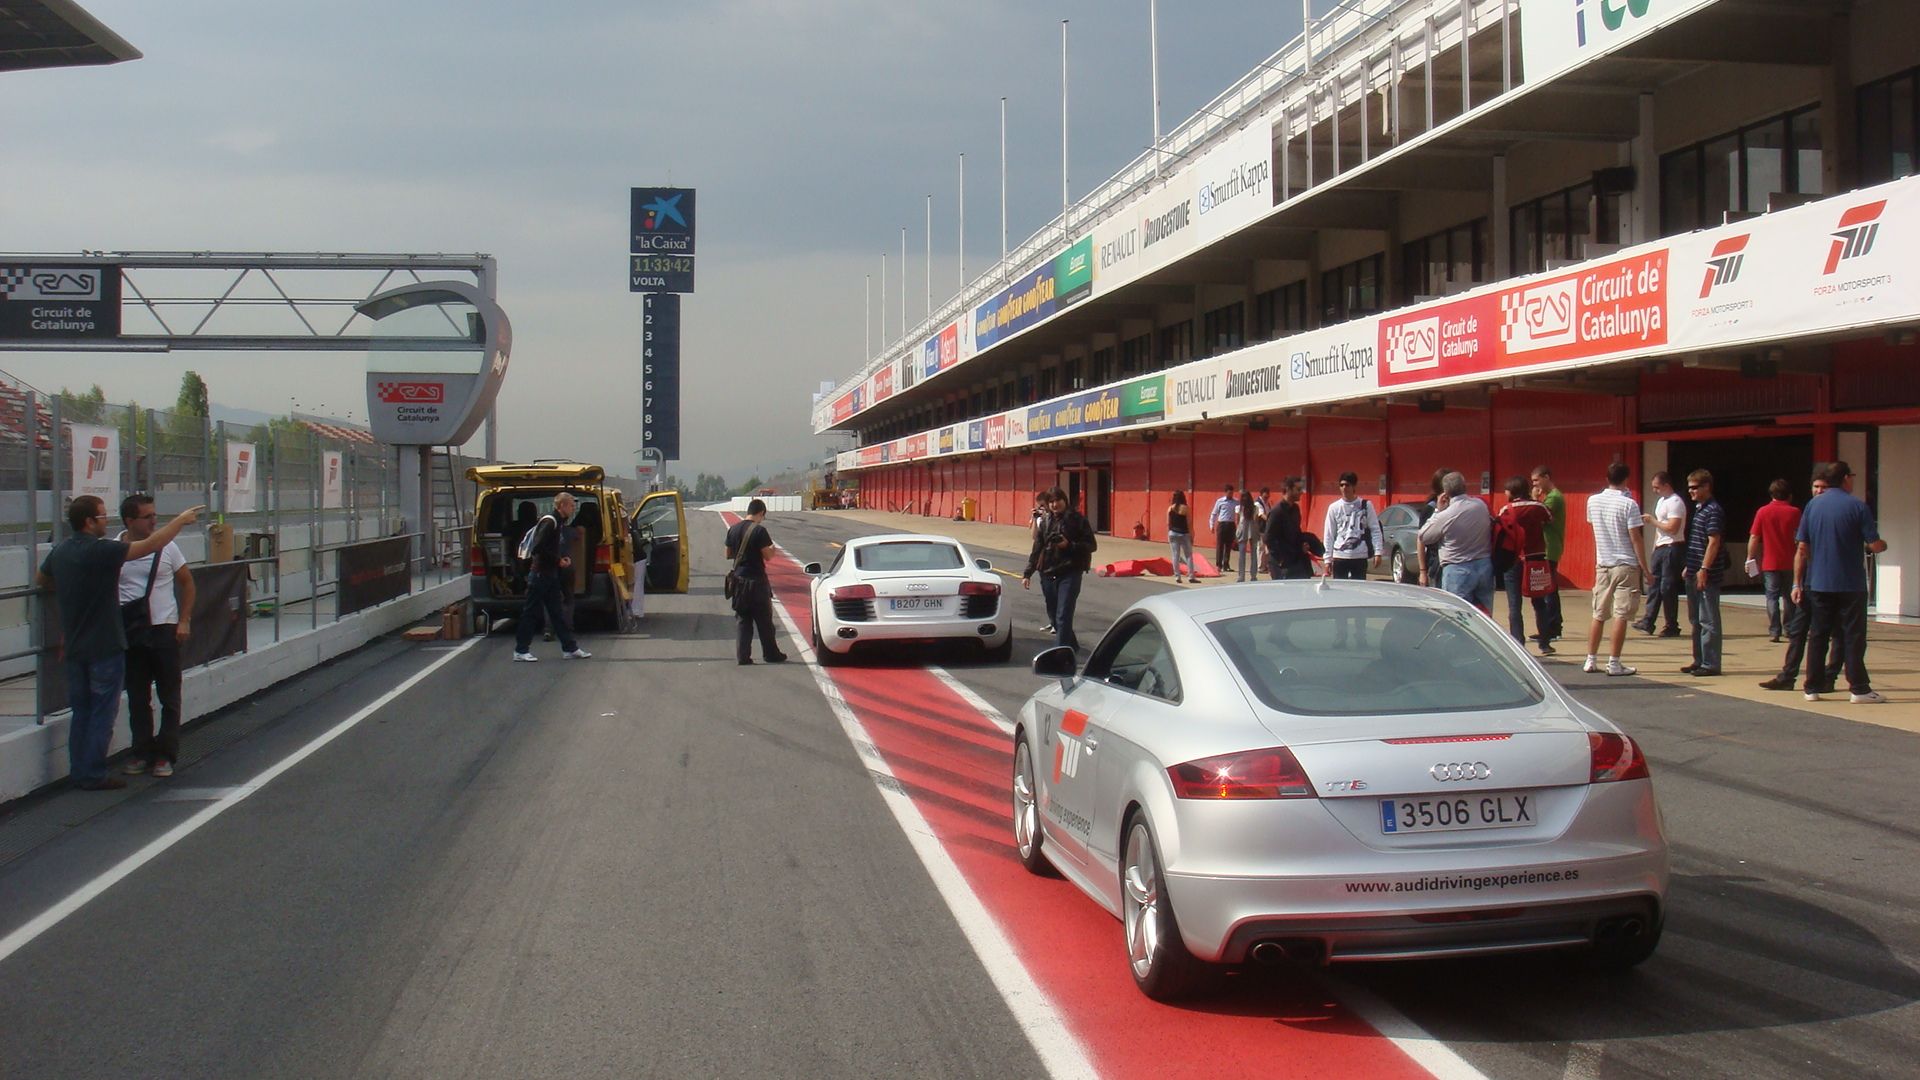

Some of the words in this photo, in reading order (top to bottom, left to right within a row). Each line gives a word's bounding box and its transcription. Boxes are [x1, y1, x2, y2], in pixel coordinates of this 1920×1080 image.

[1210, 171, 1239, 209] Smurfit
[1240, 159, 1268, 197] Kappa
[1144, 199, 1191, 248] BRIDGESTONE
[1101, 228, 1137, 270] RENAULT
[633, 277, 666, 286] VOLTA
[1582, 266, 1633, 306] Circuit
[1638, 260, 1660, 293] de
[1814, 284, 1836, 296] FORZA
[1838, 277, 1885, 291] MOTORSPORT
[646, 299, 651, 307] 1
[32, 307, 74, 318] Circuit
[76, 307, 92, 318] de
[646, 315, 652, 324] 2
[31, 320, 95, 332] Catalunya
[1442, 320, 1465, 339] Circuit
[1466, 317, 1477, 334] de
[1581, 304, 1661, 341] Catalunya
[646, 332, 652, 341] 3
[645, 348, 652, 357] 4
[1442, 337, 1478, 358] Catalunya
[1304, 345, 1340, 379] Smurfit
[1340, 342, 1373, 379] Kappa
[646, 365, 652, 374] 5
[645, 381, 652, 390] 6
[1226, 364, 1281, 399] BRIDGESTONE
[1177, 374, 1217, 406] RENAULT
[645, 398, 652, 407] 7
[1085, 391, 1119, 428] GOODYEAR
[397, 414, 440, 423] Catalunya
[645, 415, 652, 424] 8
[1055, 402, 1082, 430] GOODYEAR
[645, 431, 652, 440] 9
[896, 600, 921, 608] 8207
[923, 599, 942, 608] GHN
[1401, 800, 1470, 828] 3506
[1480, 796, 1530, 823] GLX
[1387, 819, 1393, 827] E
[1346, 869, 1579, 893] www.audidrivingexperience.es
